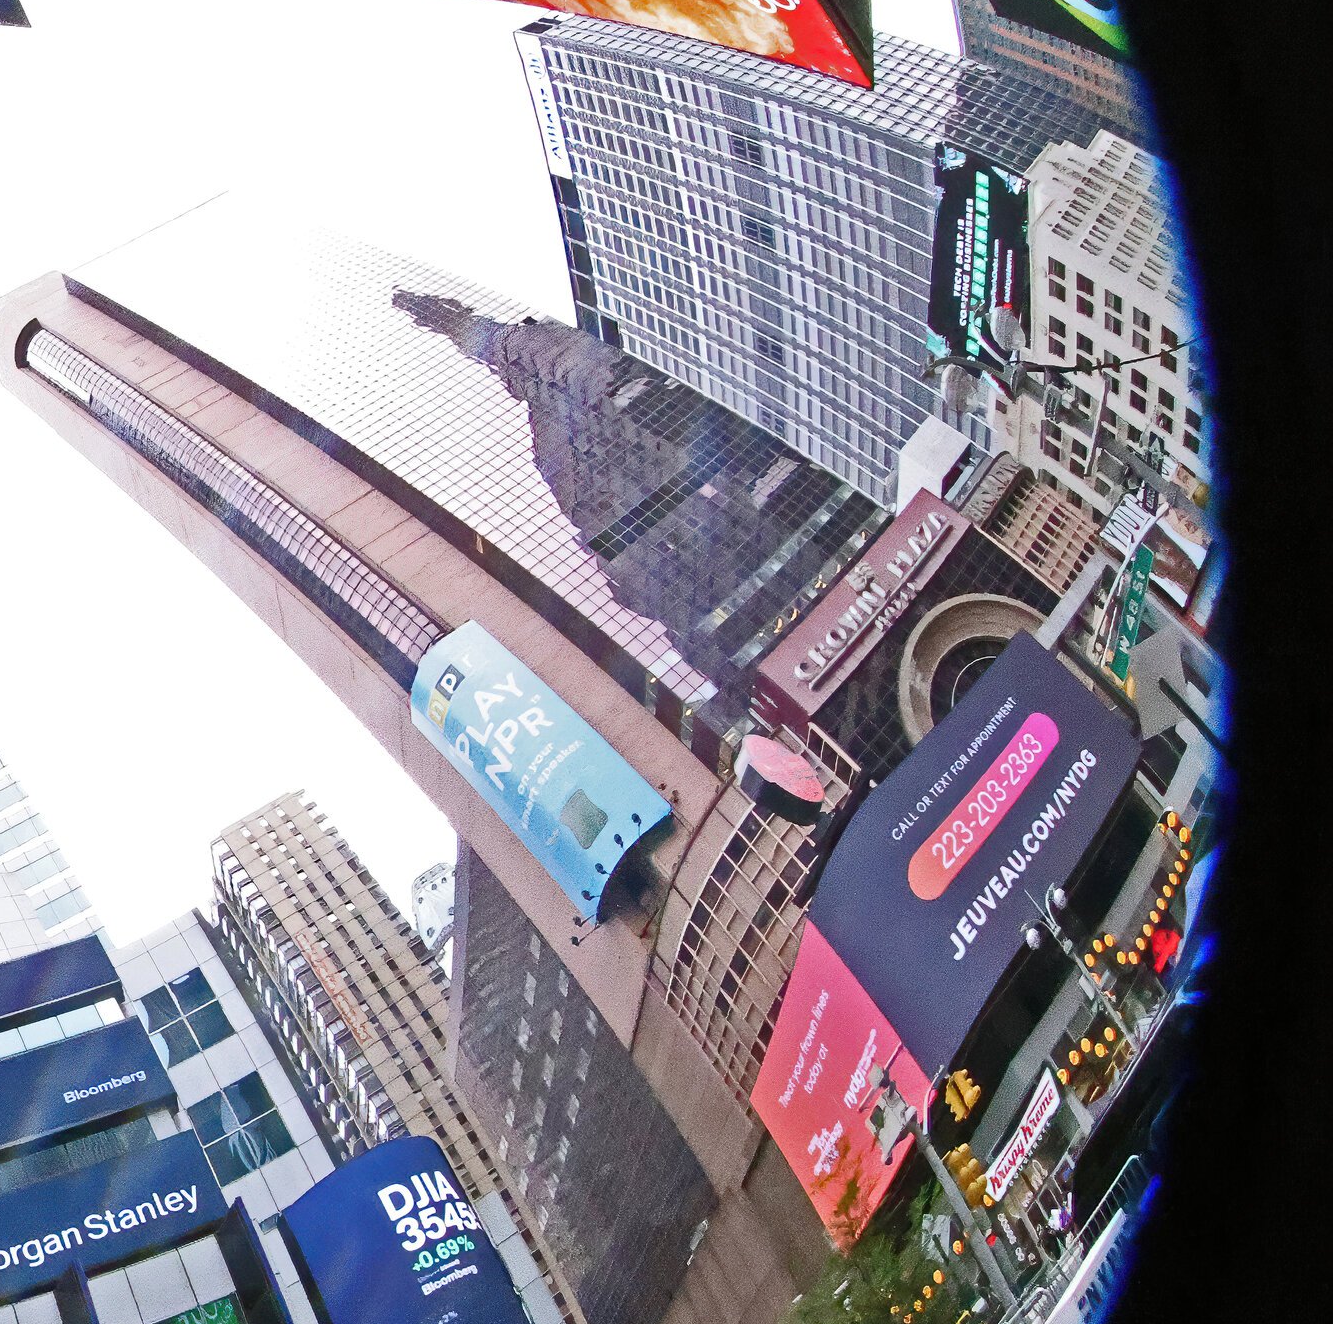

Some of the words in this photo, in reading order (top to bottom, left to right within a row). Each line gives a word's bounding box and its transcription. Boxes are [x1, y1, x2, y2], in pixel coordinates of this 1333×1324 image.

[529, 741, 555, 774] your
[889, 809, 920, 842] CALL
[914, 792, 934, 815] OR
[928, 769, 954, 798] TEXT
[947, 751, 970, 776] FOR
[963, 696, 1019, 757] APPOINTMENT
[931, 732, 1043, 870] 223-203-2363
[952, 749, 1098, 962] JEUVEAU.COM/NYDG
[811, 988, 831, 1019] lines
[63, 1069, 146, 1104] Bloomberg
[86, 1184, 202, 1243] Stanley
[377, 1170, 460, 1222] DJIA
[411, 1234, 475, 1274] +0.69%
[420, 1263, 479, 1296] Bloomberg
